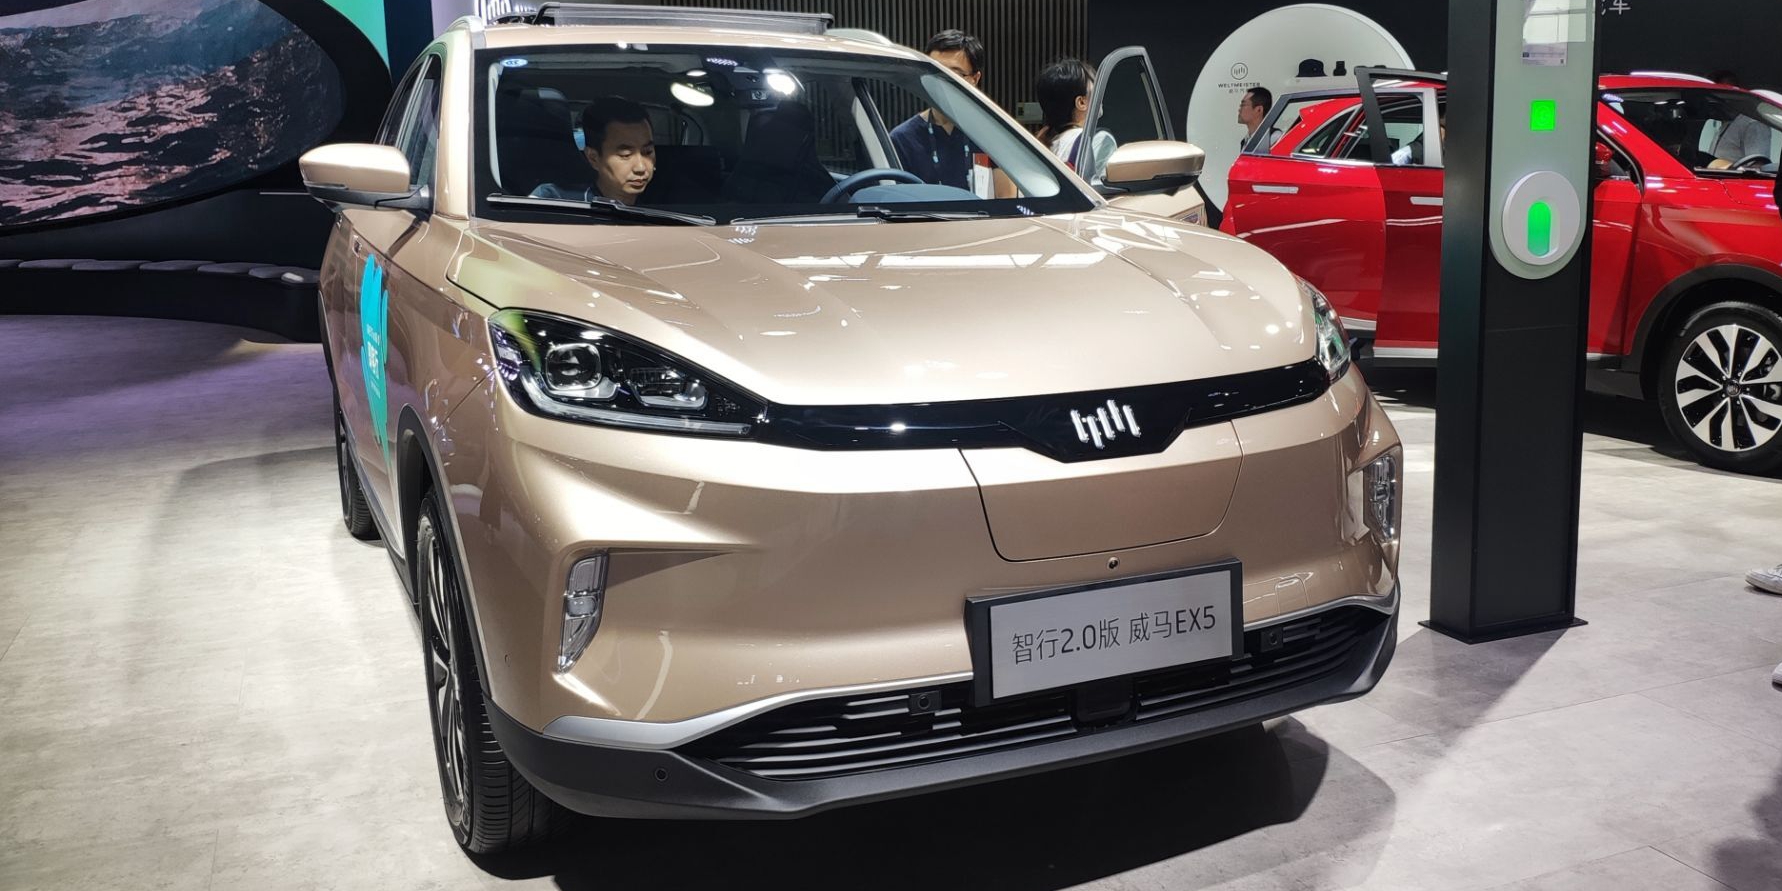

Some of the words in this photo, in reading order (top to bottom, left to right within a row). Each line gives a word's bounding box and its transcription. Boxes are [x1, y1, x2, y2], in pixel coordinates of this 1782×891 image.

[1602, 0, 1631, 15] 车
[1012, 617, 1121, 665] 智行2.0版
[1128, 605, 1216, 644] 威马EX5
